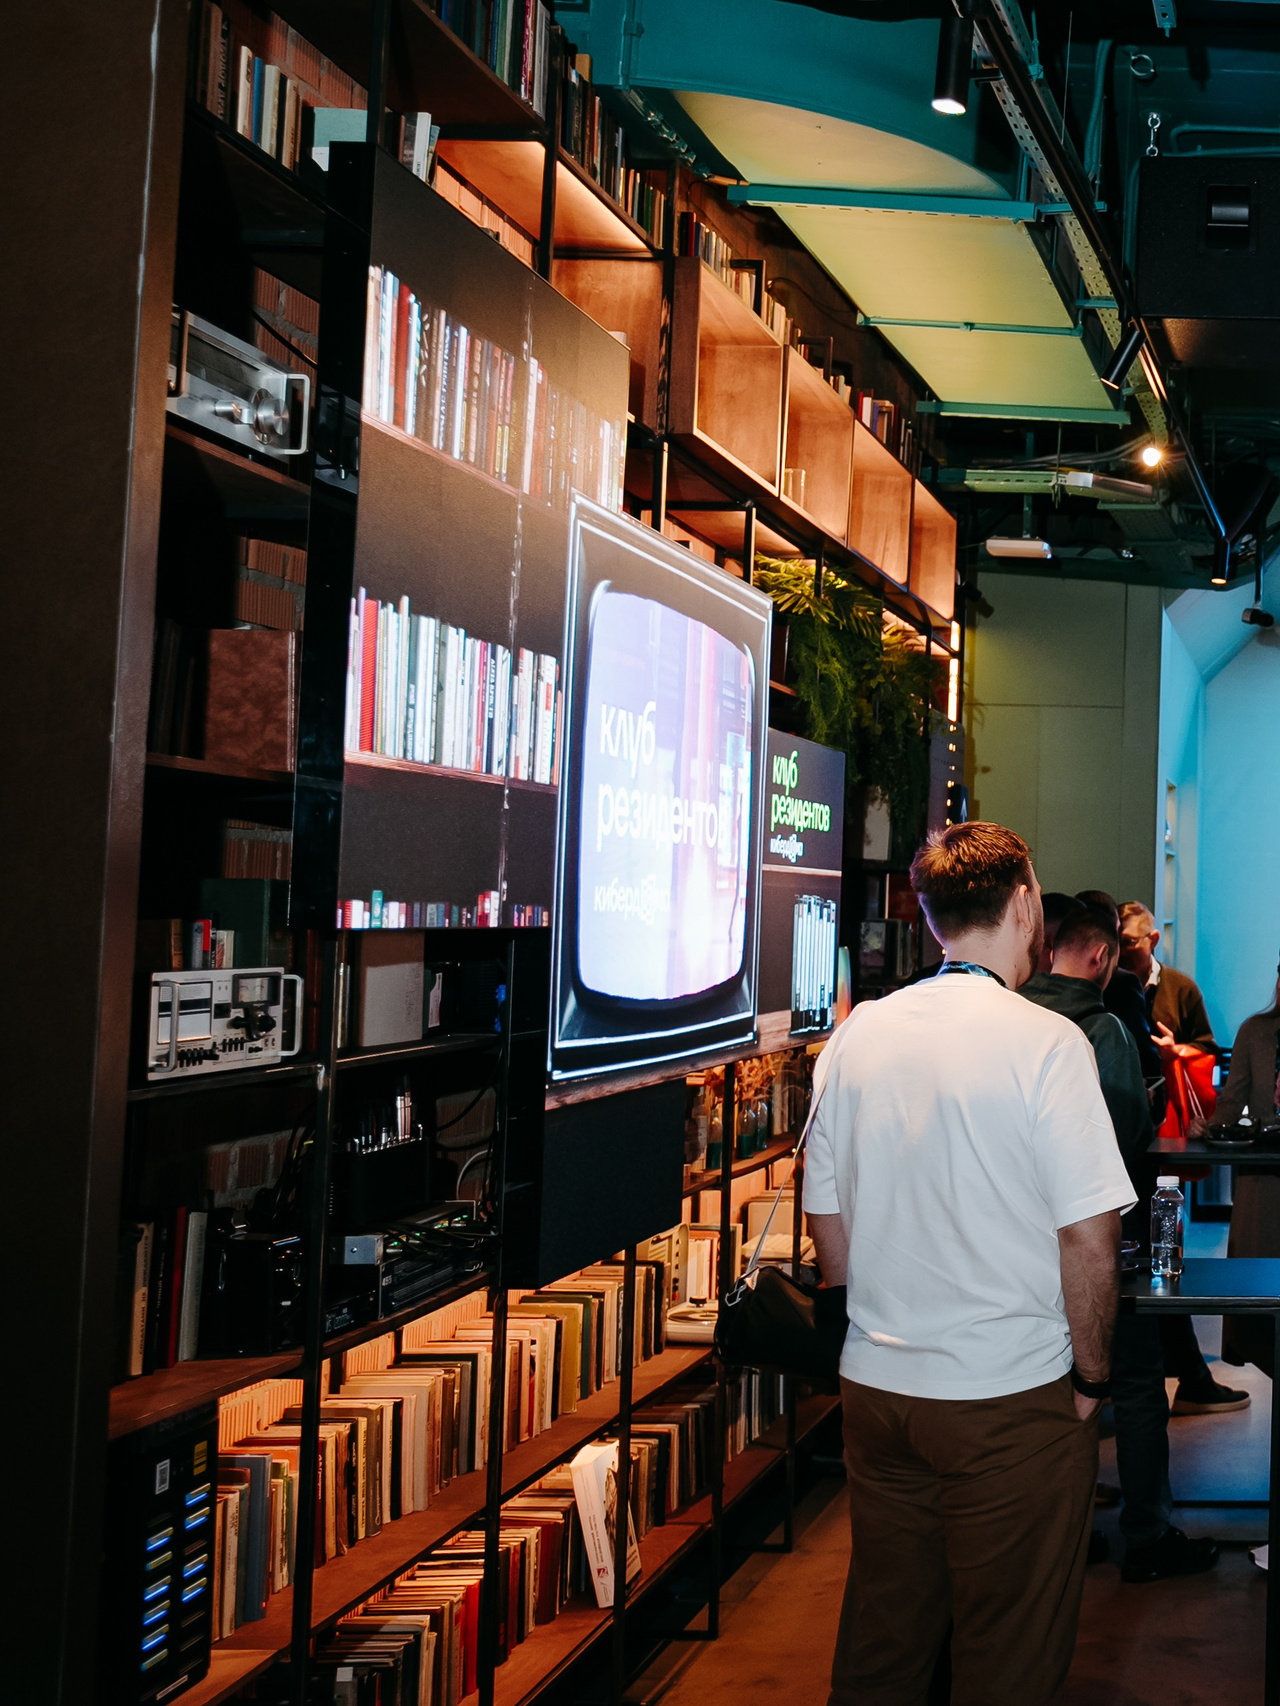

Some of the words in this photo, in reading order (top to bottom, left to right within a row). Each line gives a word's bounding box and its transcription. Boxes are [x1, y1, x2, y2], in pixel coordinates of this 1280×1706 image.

[600, 701, 656, 779] клуб
[772, 750, 798, 796] клуб
[596, 783, 732, 852] резидентов
[770, 793, 831, 832] резидентов
